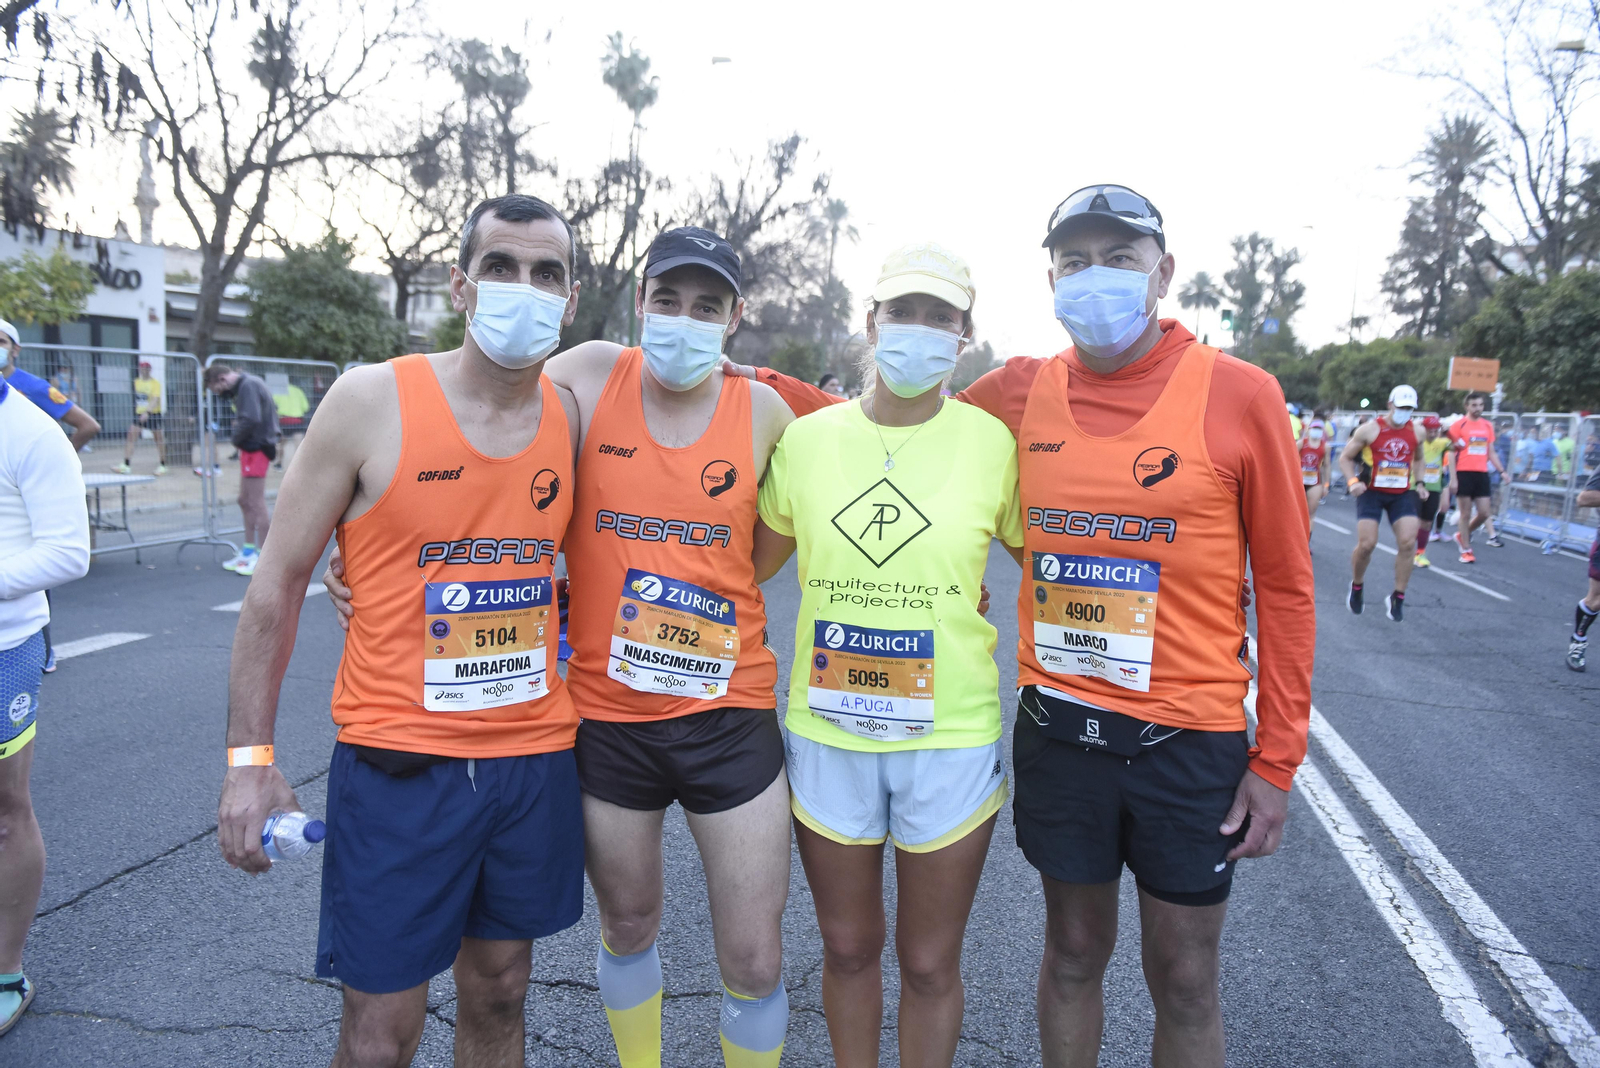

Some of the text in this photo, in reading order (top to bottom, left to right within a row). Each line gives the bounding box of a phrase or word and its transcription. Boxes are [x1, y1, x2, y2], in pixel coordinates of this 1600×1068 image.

[596, 509, 731, 548] PEGADA
[1027, 506, 1177, 544] PEGADA
[418, 538, 555, 567] PEGADA
[1064, 562, 1141, 583] ZURICH
[475, 585, 541, 605] ZURICH
[808, 577, 962, 596] arquitectura &
[665, 587, 723, 618] ZURICH
[830, 592, 934, 610] projectos
[1065, 601, 1106, 623] 4900
[475, 626, 518, 648] 5104
[657, 623, 700, 647] 3752
[848, 632, 918, 652] ZURICH
[1063, 631, 1108, 652] MARCO
[455, 655, 532, 678] MARAFONA
[623, 643, 722, 674] NNASCIMENTO
[848, 668, 889, 688] 5095
[840, 696, 894, 713] A.PUGA
[1079, 735, 1107, 746] salomon
